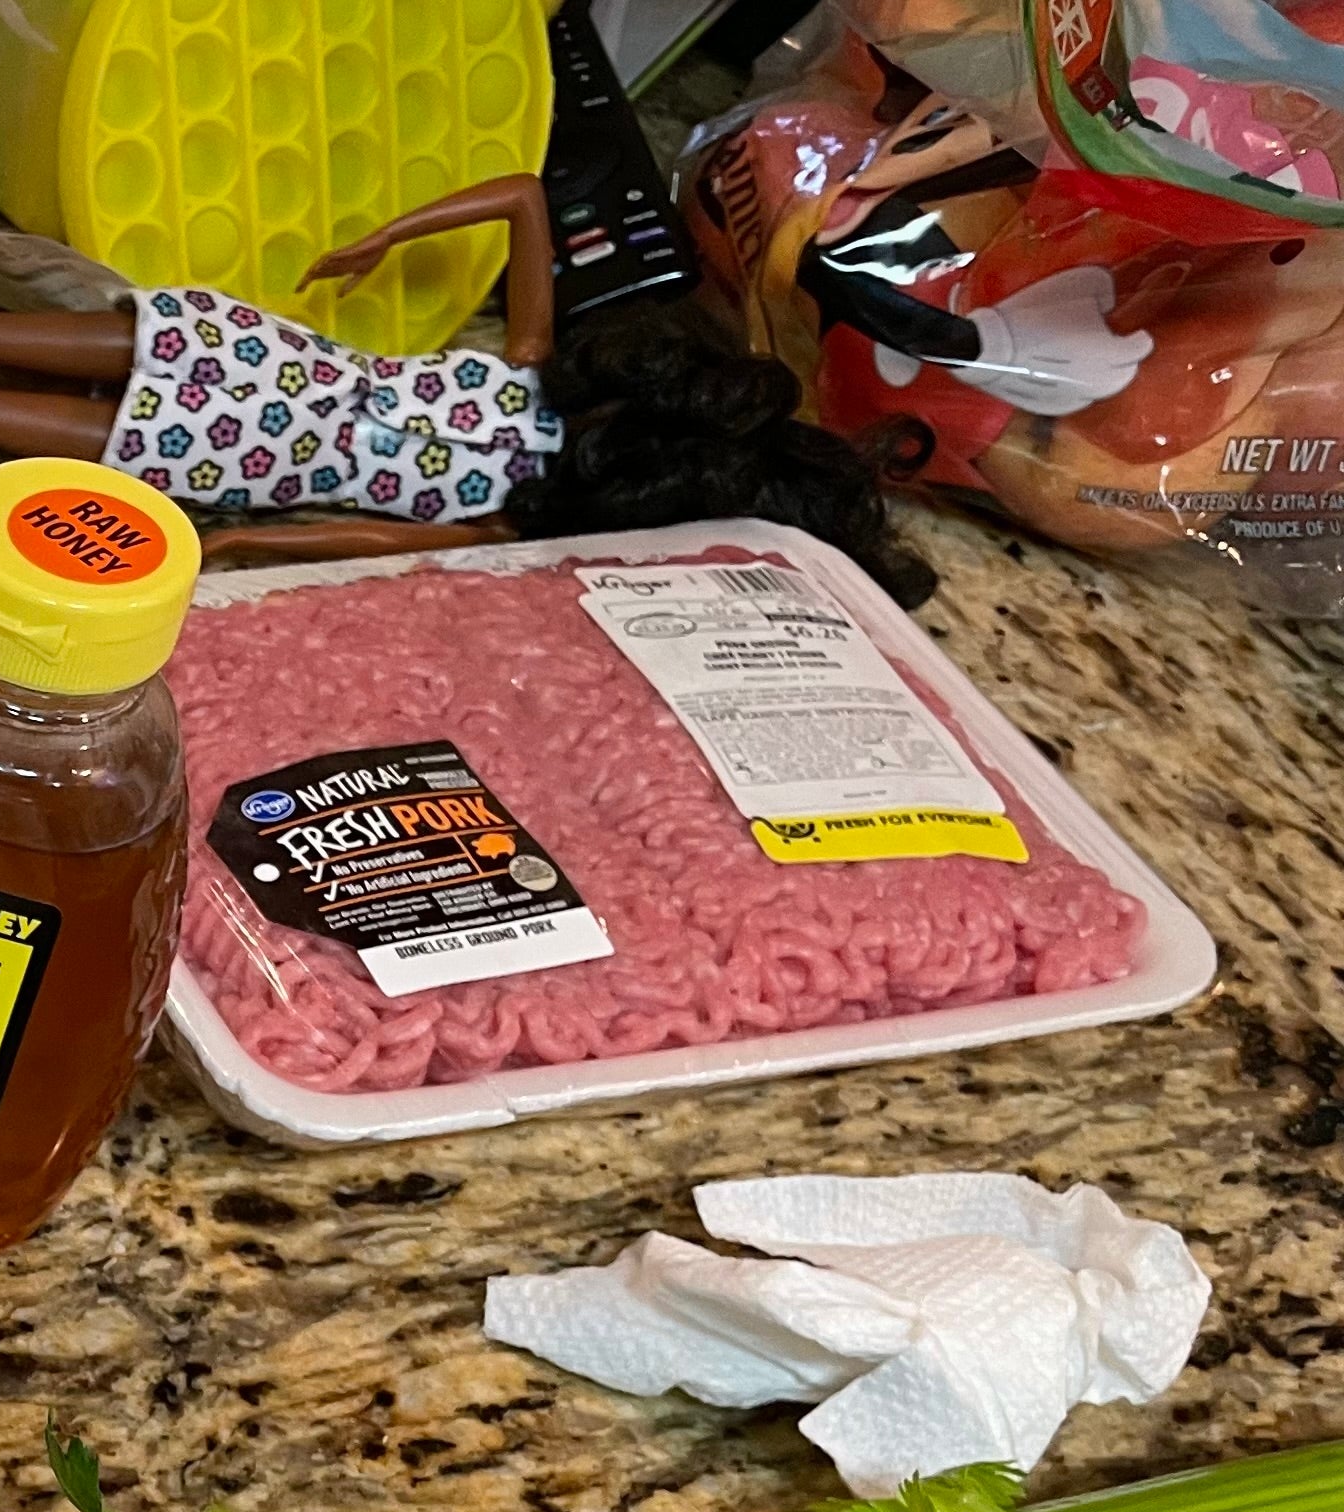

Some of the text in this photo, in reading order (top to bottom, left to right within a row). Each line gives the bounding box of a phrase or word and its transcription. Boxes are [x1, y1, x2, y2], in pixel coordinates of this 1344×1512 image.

[1222, 439, 1337, 473] NET WT
[1271, 493, 1317, 512] EXTRA
[21, 505, 133, 575] HONEY
[68, 500, 152, 550] RAW
[1230, 519, 1304, 538] PRODUCE
[1305, 518, 1325, 537] OF
[591, 573, 672, 597] Kroger
[295, 763, 410, 813] NATURAL
[276, 796, 505, 871] FRESH PORK
[825, 818, 876, 831] FRESH
[879, 813, 913, 826] FOR
[331, 849, 425, 877] No Preservatives
[363, 872, 412, 893] Artificial
[410, 862, 472, 884] Ingredients
[394, 918, 558, 960] BONELESS GROUND PORK
